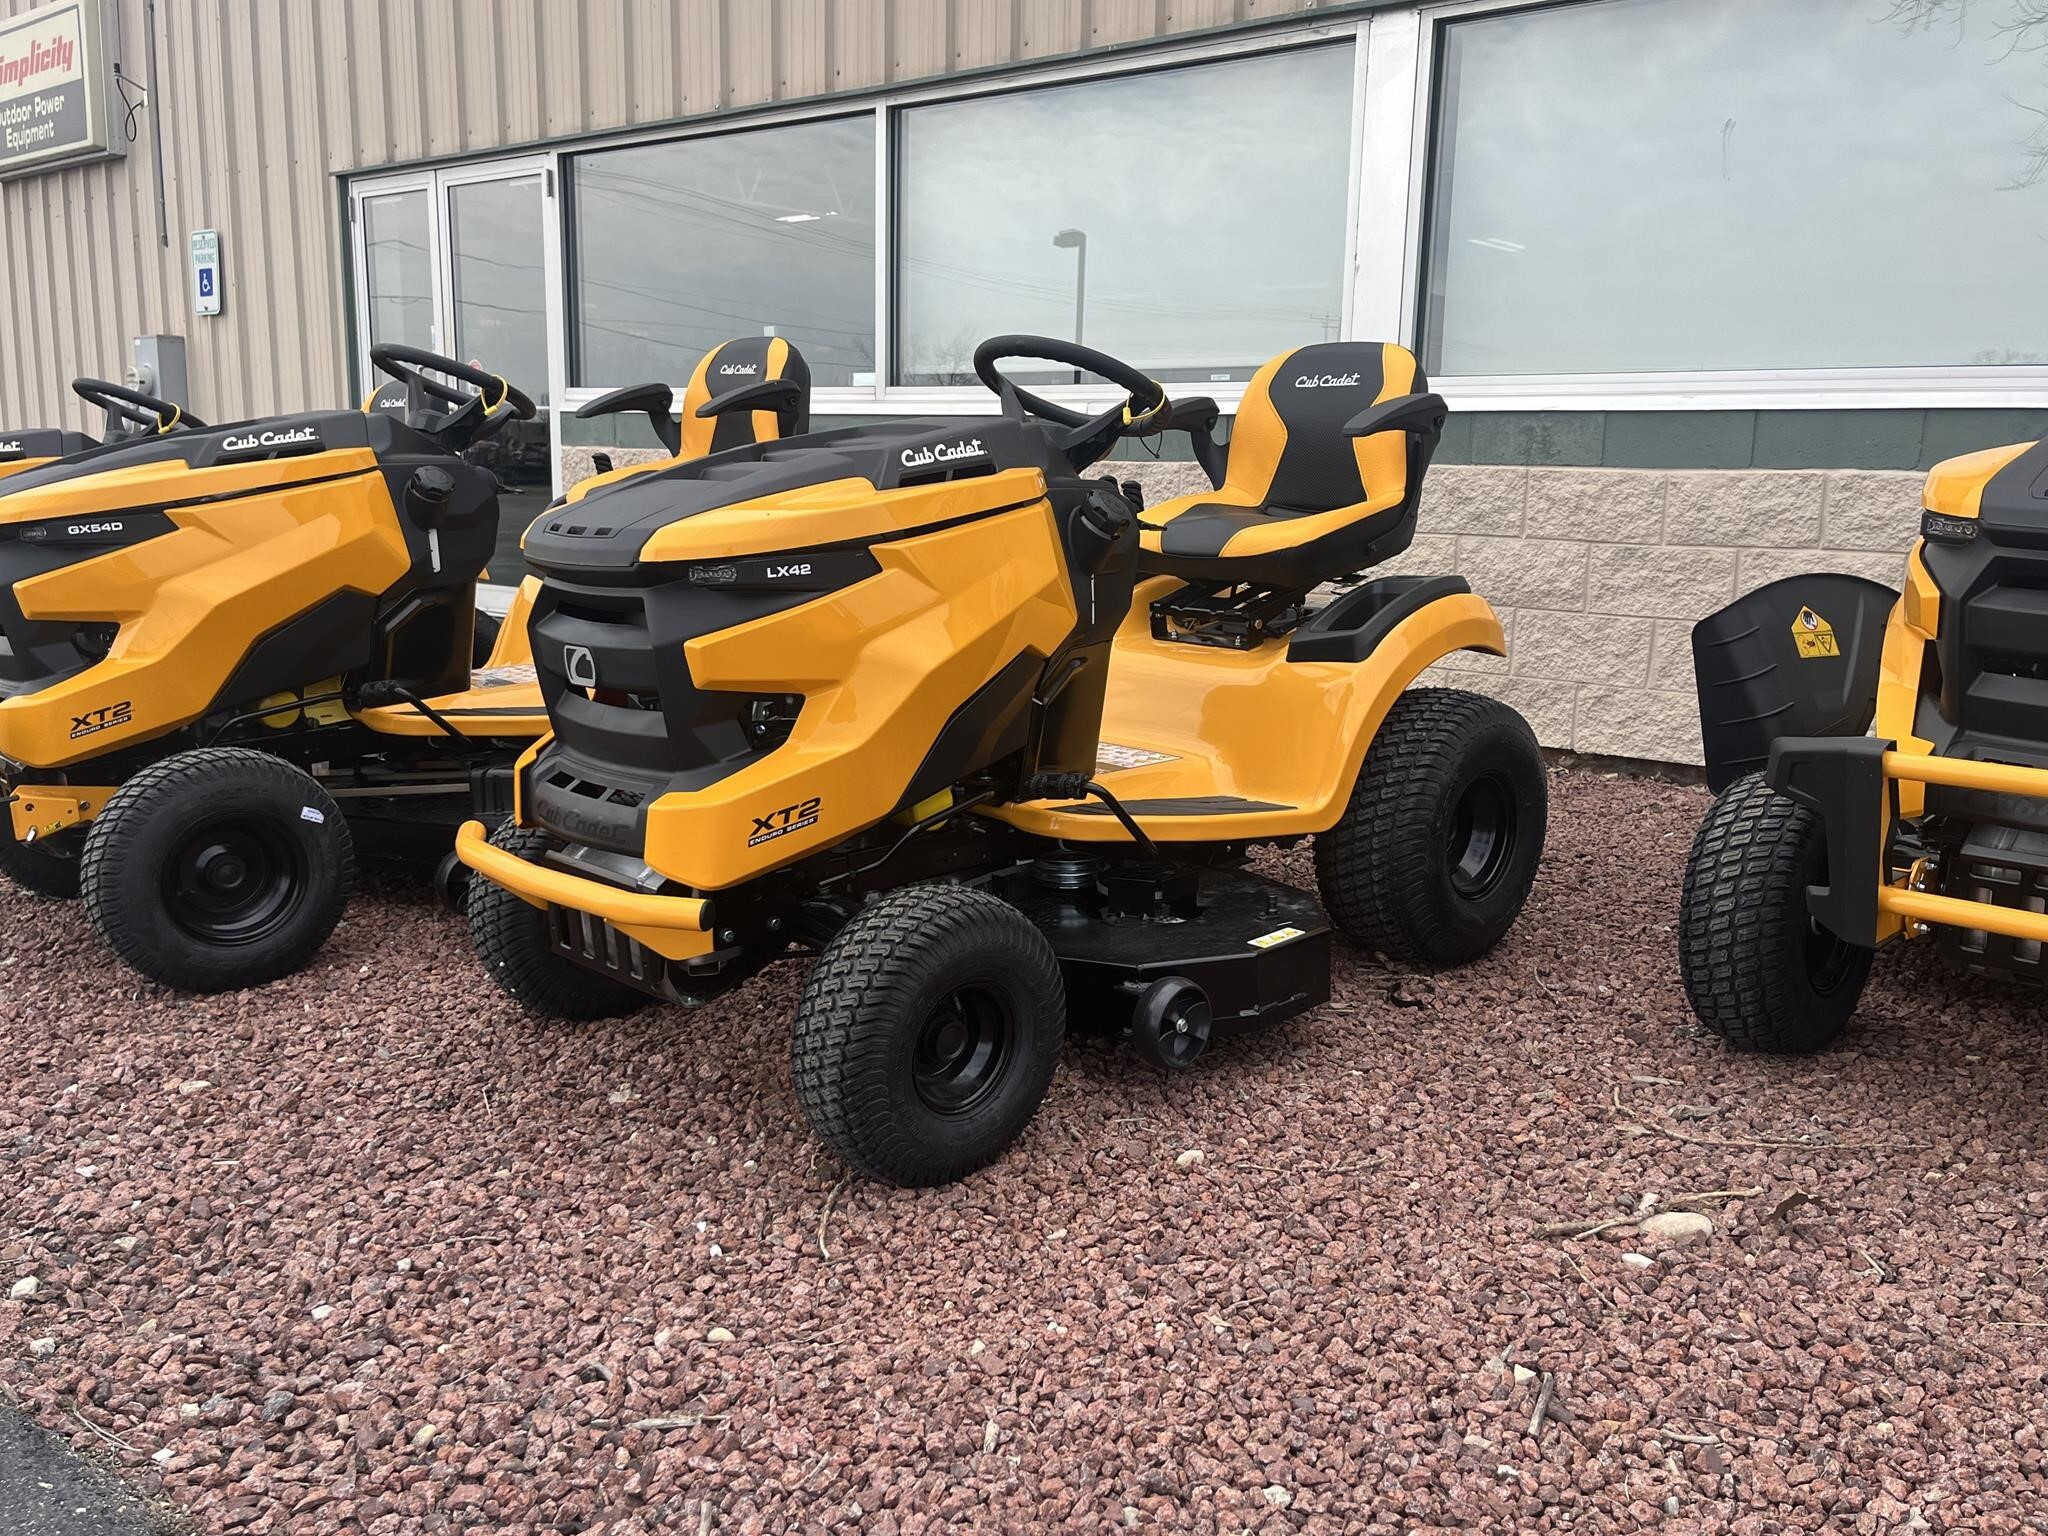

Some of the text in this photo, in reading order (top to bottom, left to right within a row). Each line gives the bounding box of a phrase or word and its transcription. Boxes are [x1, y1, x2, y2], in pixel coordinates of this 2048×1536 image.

[0, 94, 65, 127] utdoor Power
[6, 119, 55, 152] Equipment
[192, 238, 216, 250] RESERVED
[194, 253, 215, 265] PARKING
[720, 363, 757, 375] Cub Cadet
[1295, 372, 1360, 388] Cub Cadet
[222, 427, 316, 451] Cub Cadet
[901, 438, 985, 467] Cub Cadet
[67, 522, 123, 535] GX54D
[766, 563, 812, 579] LX42
[71, 701, 131, 732] XT2
[71, 716, 129, 738] ENDURO SERIES
[538, 800, 632, 845] Cub Cadet
[749, 797, 821, 837] XT2
[749, 817, 815, 846] ENDURO SERIES
